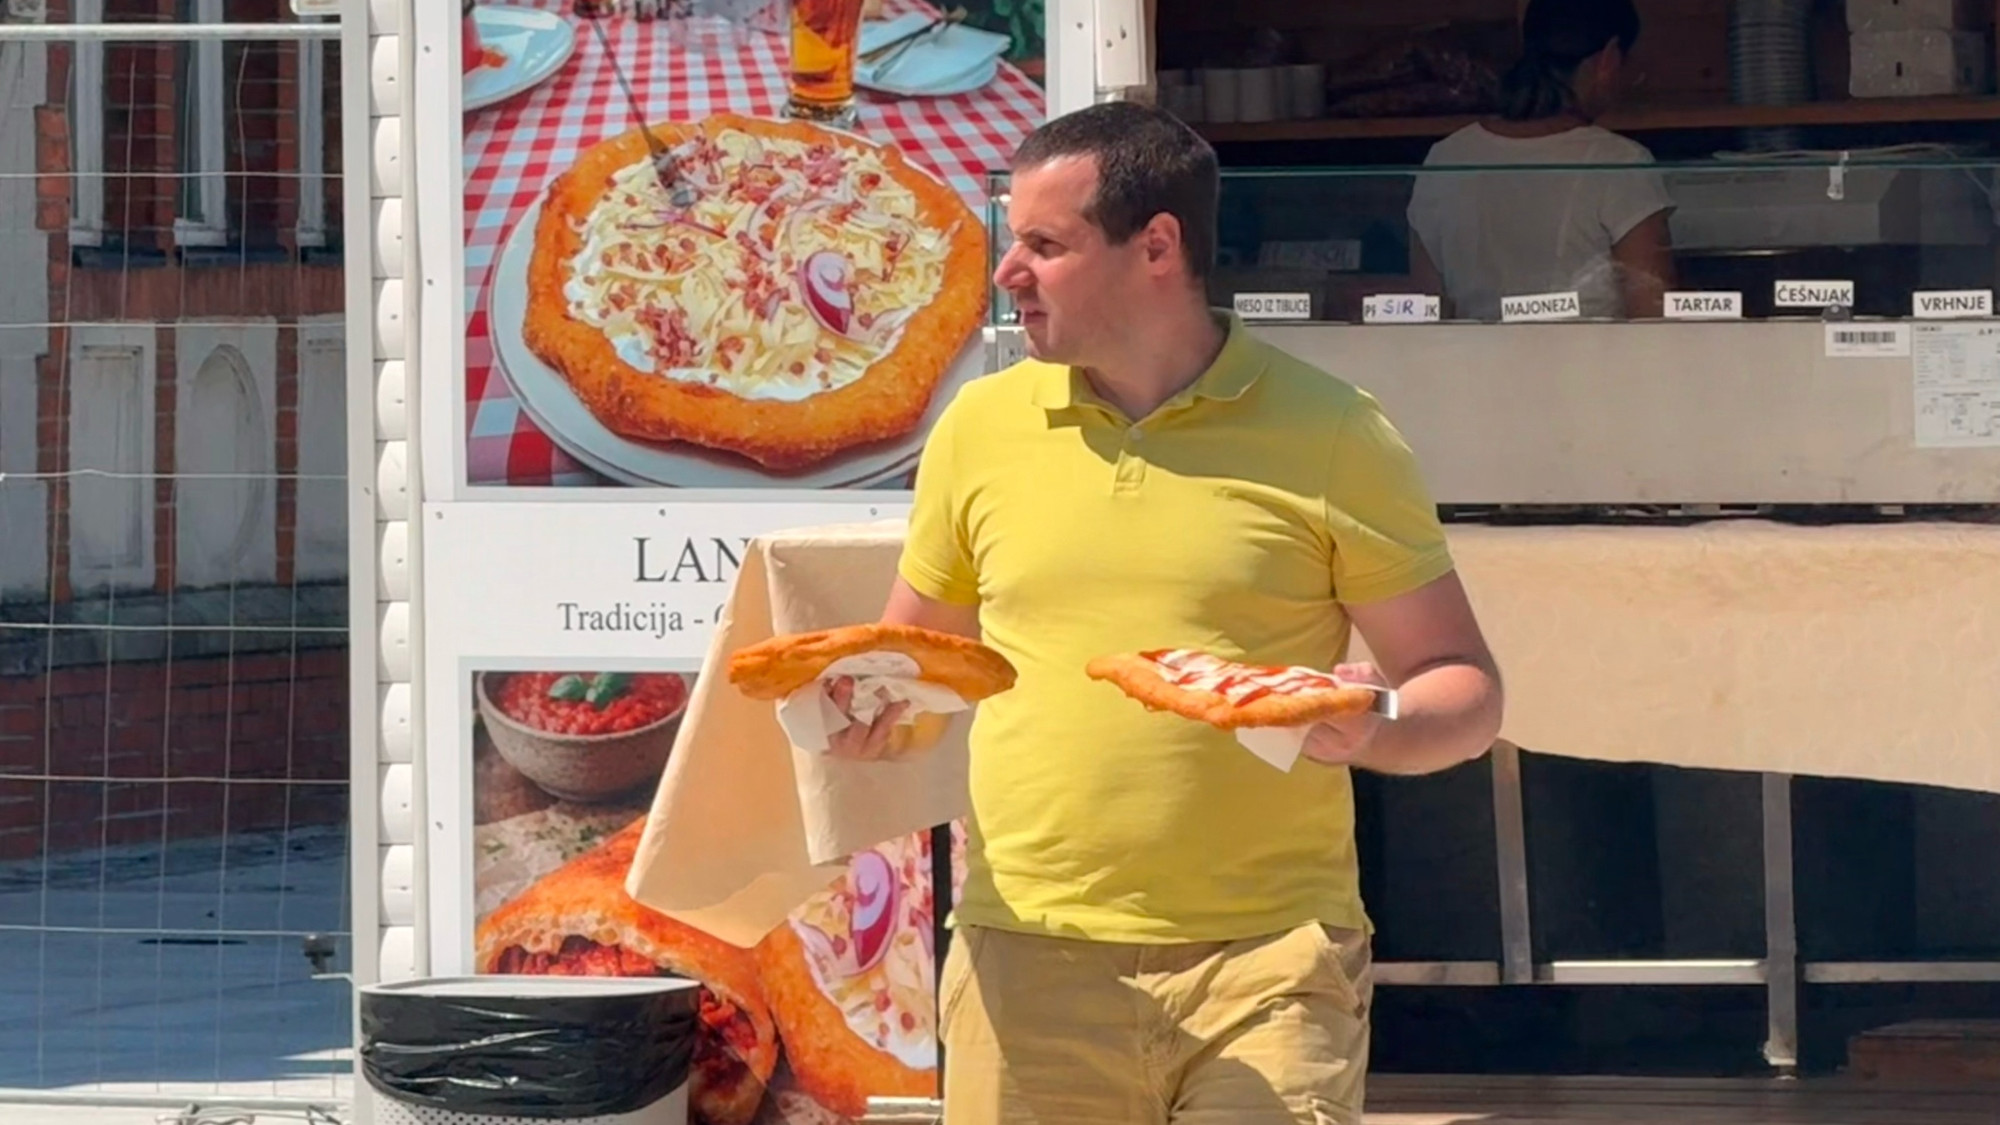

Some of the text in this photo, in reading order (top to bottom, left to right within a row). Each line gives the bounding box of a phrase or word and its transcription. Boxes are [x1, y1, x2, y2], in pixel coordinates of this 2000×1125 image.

[1777, 284, 1850, 302] ČEŠNJAK
[1236, 299, 1262, 312] MESO
[1382, 299, 1413, 315] SIR
[1504, 298, 1576, 316] MAJONEZA
[1672, 297, 1733, 312] TARTAR
[1920, 297, 1985, 311] VRHNJE
[557, 602, 683, 639] Tradicija
